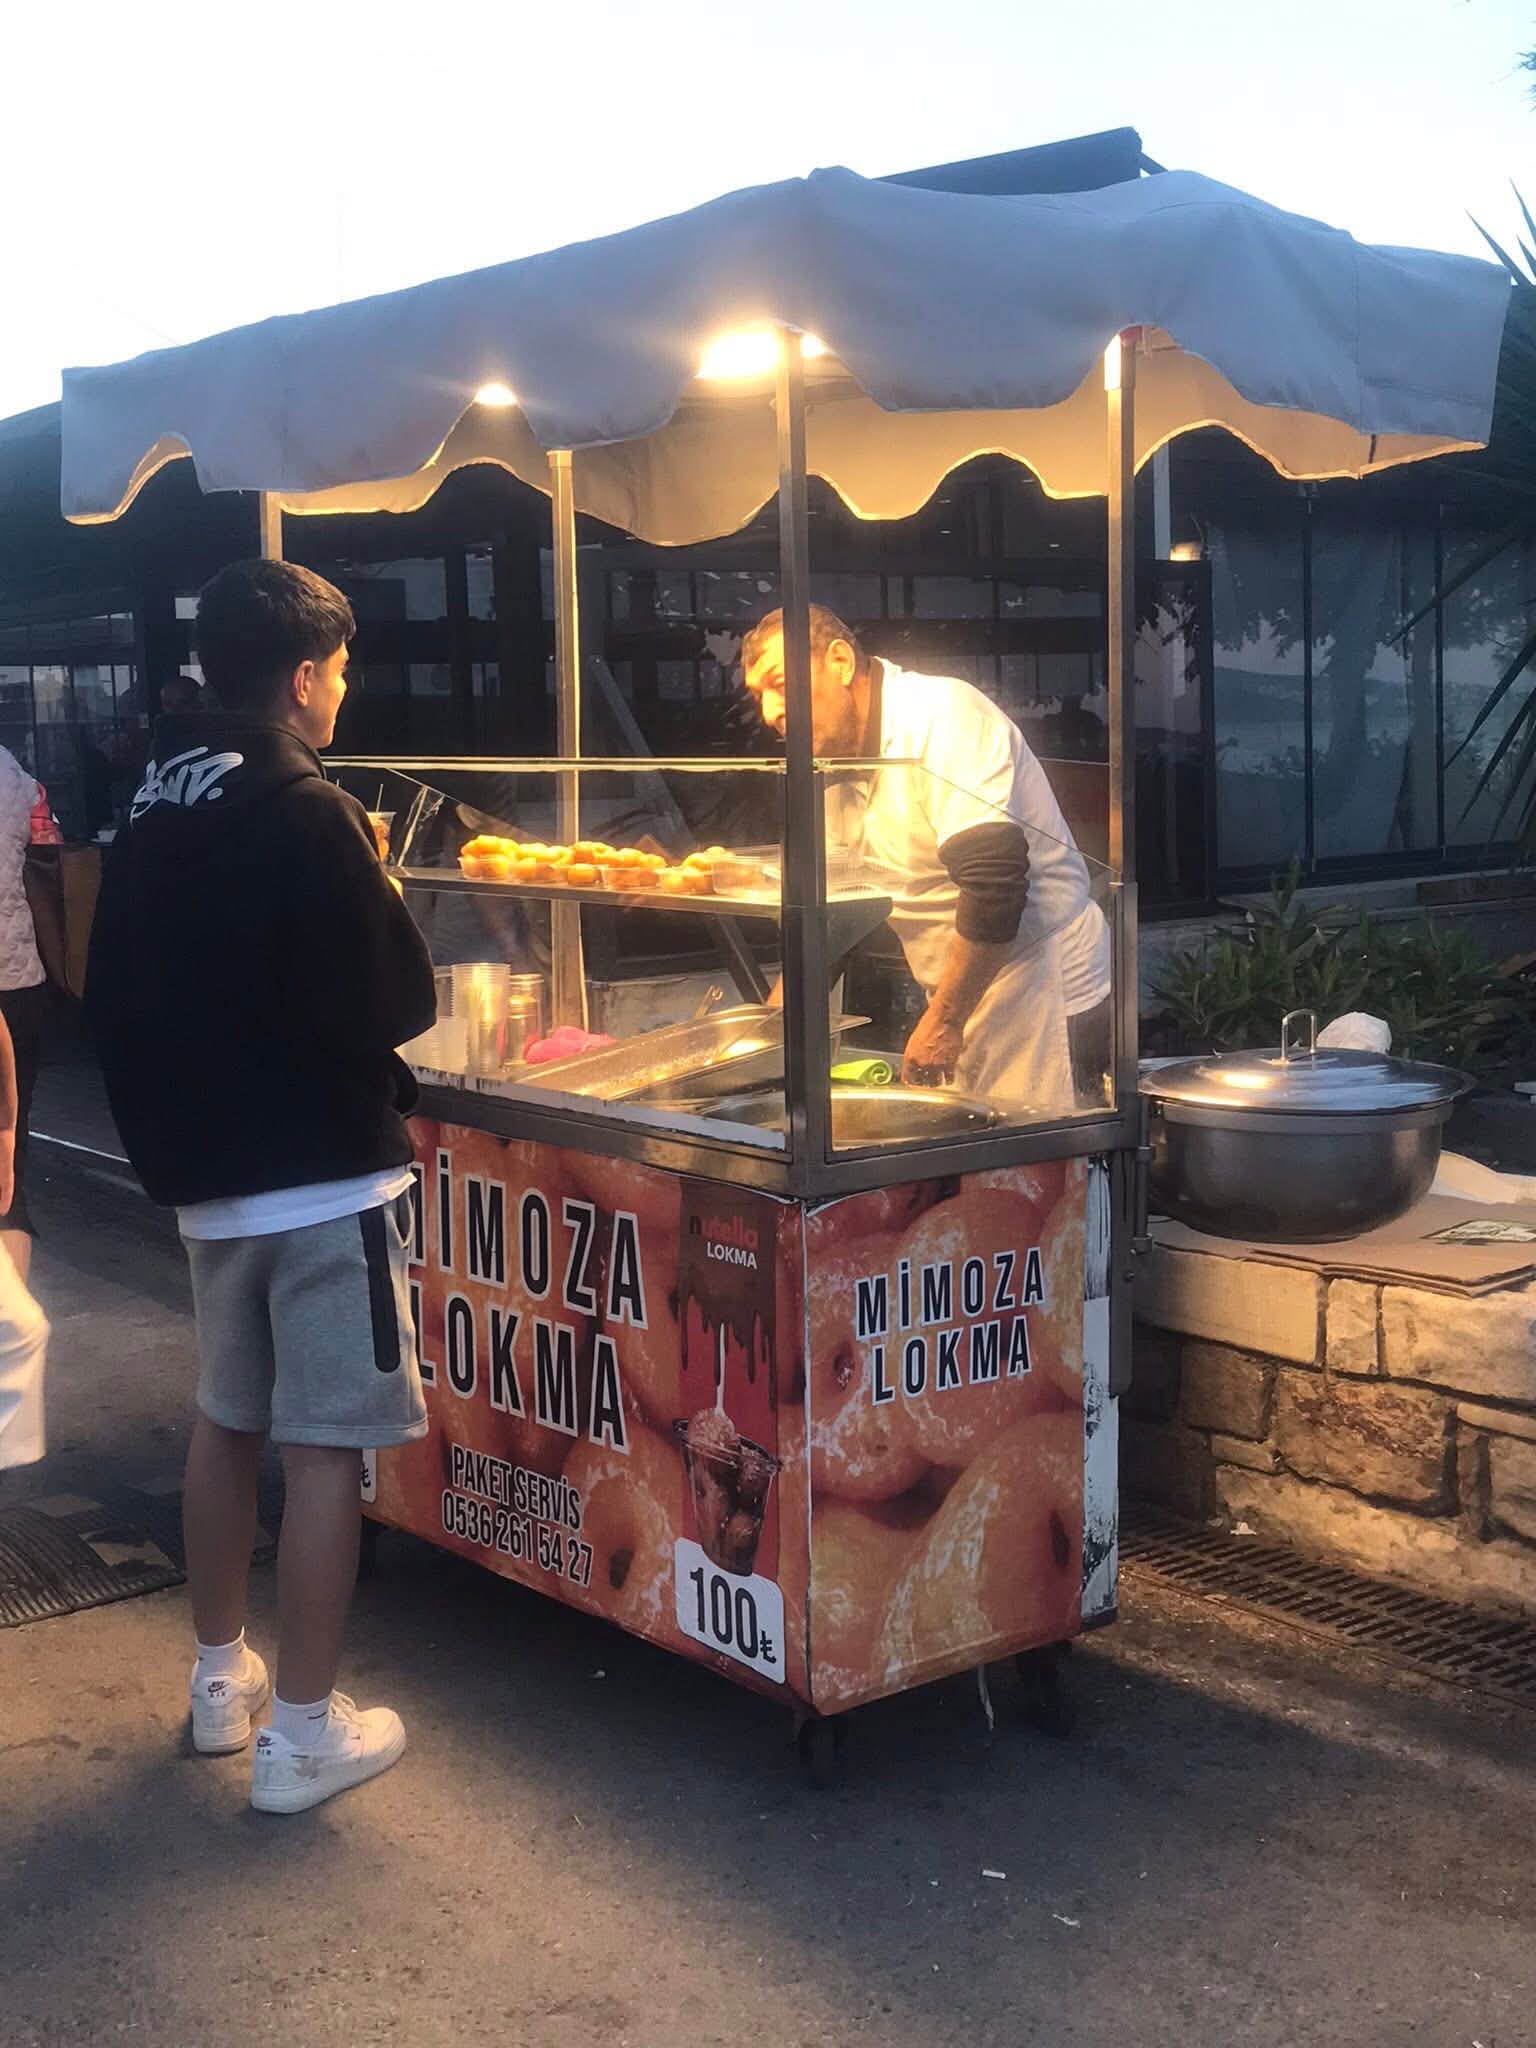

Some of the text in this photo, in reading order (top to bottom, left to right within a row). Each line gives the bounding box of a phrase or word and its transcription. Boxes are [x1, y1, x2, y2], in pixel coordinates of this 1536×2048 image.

[706, 1241, 758, 1270] LOKMA
[855, 1246, 1044, 1341] MİMOZA
[409, 1280, 630, 1455] LOKMA
[871, 1314, 1032, 1407] LOKMA
[451, 1443, 582, 1532] PAKET SERVİS
[442, 1489, 594, 1588] 0536 261 54 27
